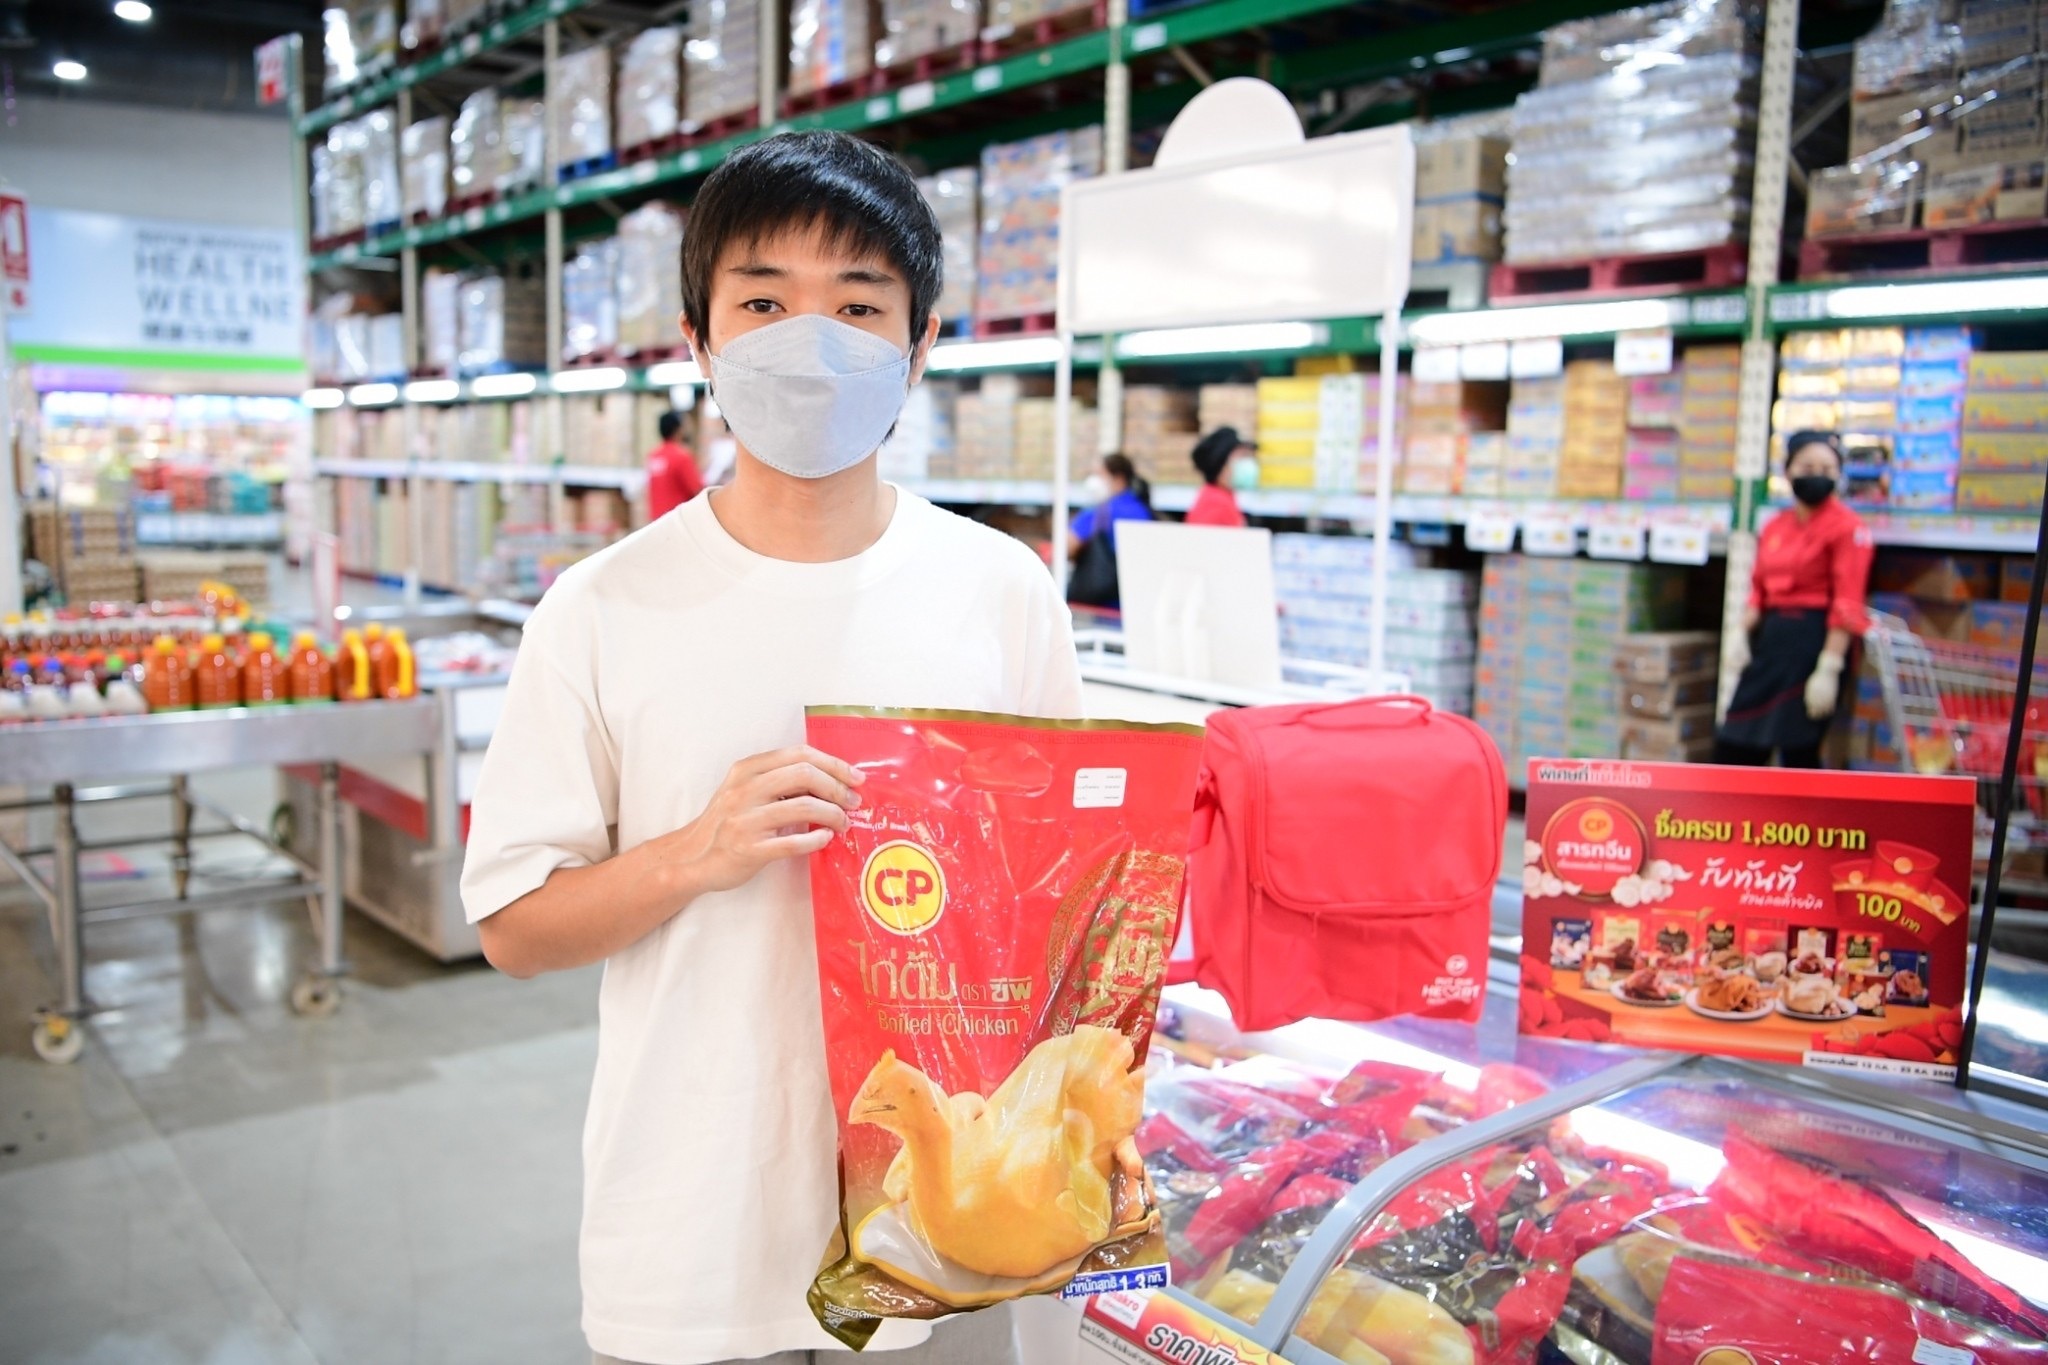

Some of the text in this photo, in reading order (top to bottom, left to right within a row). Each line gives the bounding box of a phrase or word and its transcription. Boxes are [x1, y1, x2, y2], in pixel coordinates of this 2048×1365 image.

[135, 251, 288, 283] HEALTH
[1584, 819, 1608, 833] CP
[1741, 820, 1811, 847] 1,800
[1817, 828, 1866, 850] บาท
[1556, 840, 1632, 861] สารทจีน
[874, 868, 934, 907] CP
[1699, 857, 1803, 893] รับทันที
[1856, 892, 1921, 934] 100 บาท
[961, 982, 988, 1001] ตรา
[878, 1009, 1020, 1036] Boiled Chicken
